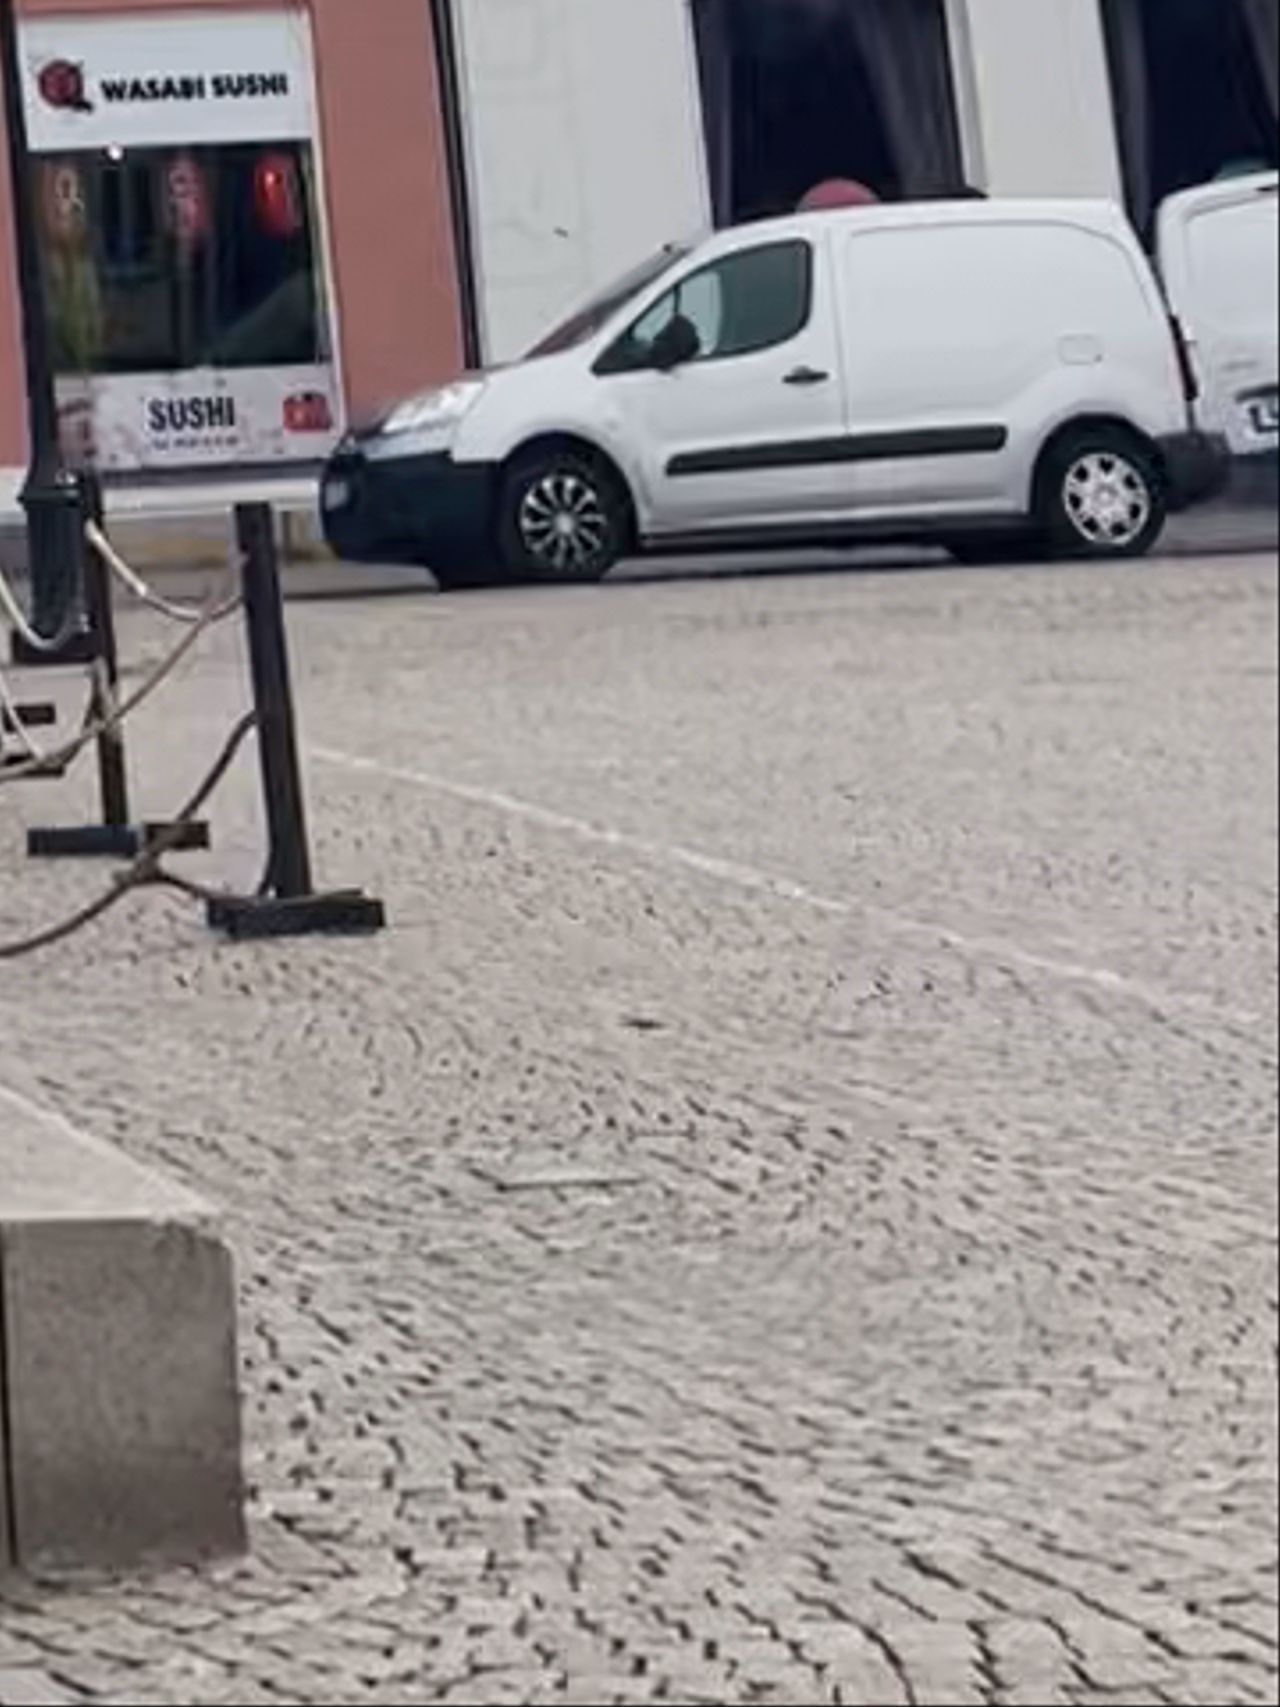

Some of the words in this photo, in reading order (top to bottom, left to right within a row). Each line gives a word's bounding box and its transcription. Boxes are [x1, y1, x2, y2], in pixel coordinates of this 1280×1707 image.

[101, 76, 205, 102] WASABI
[212, 73, 289, 98] SUSHI
[148, 396, 235, 430] SUSHI
